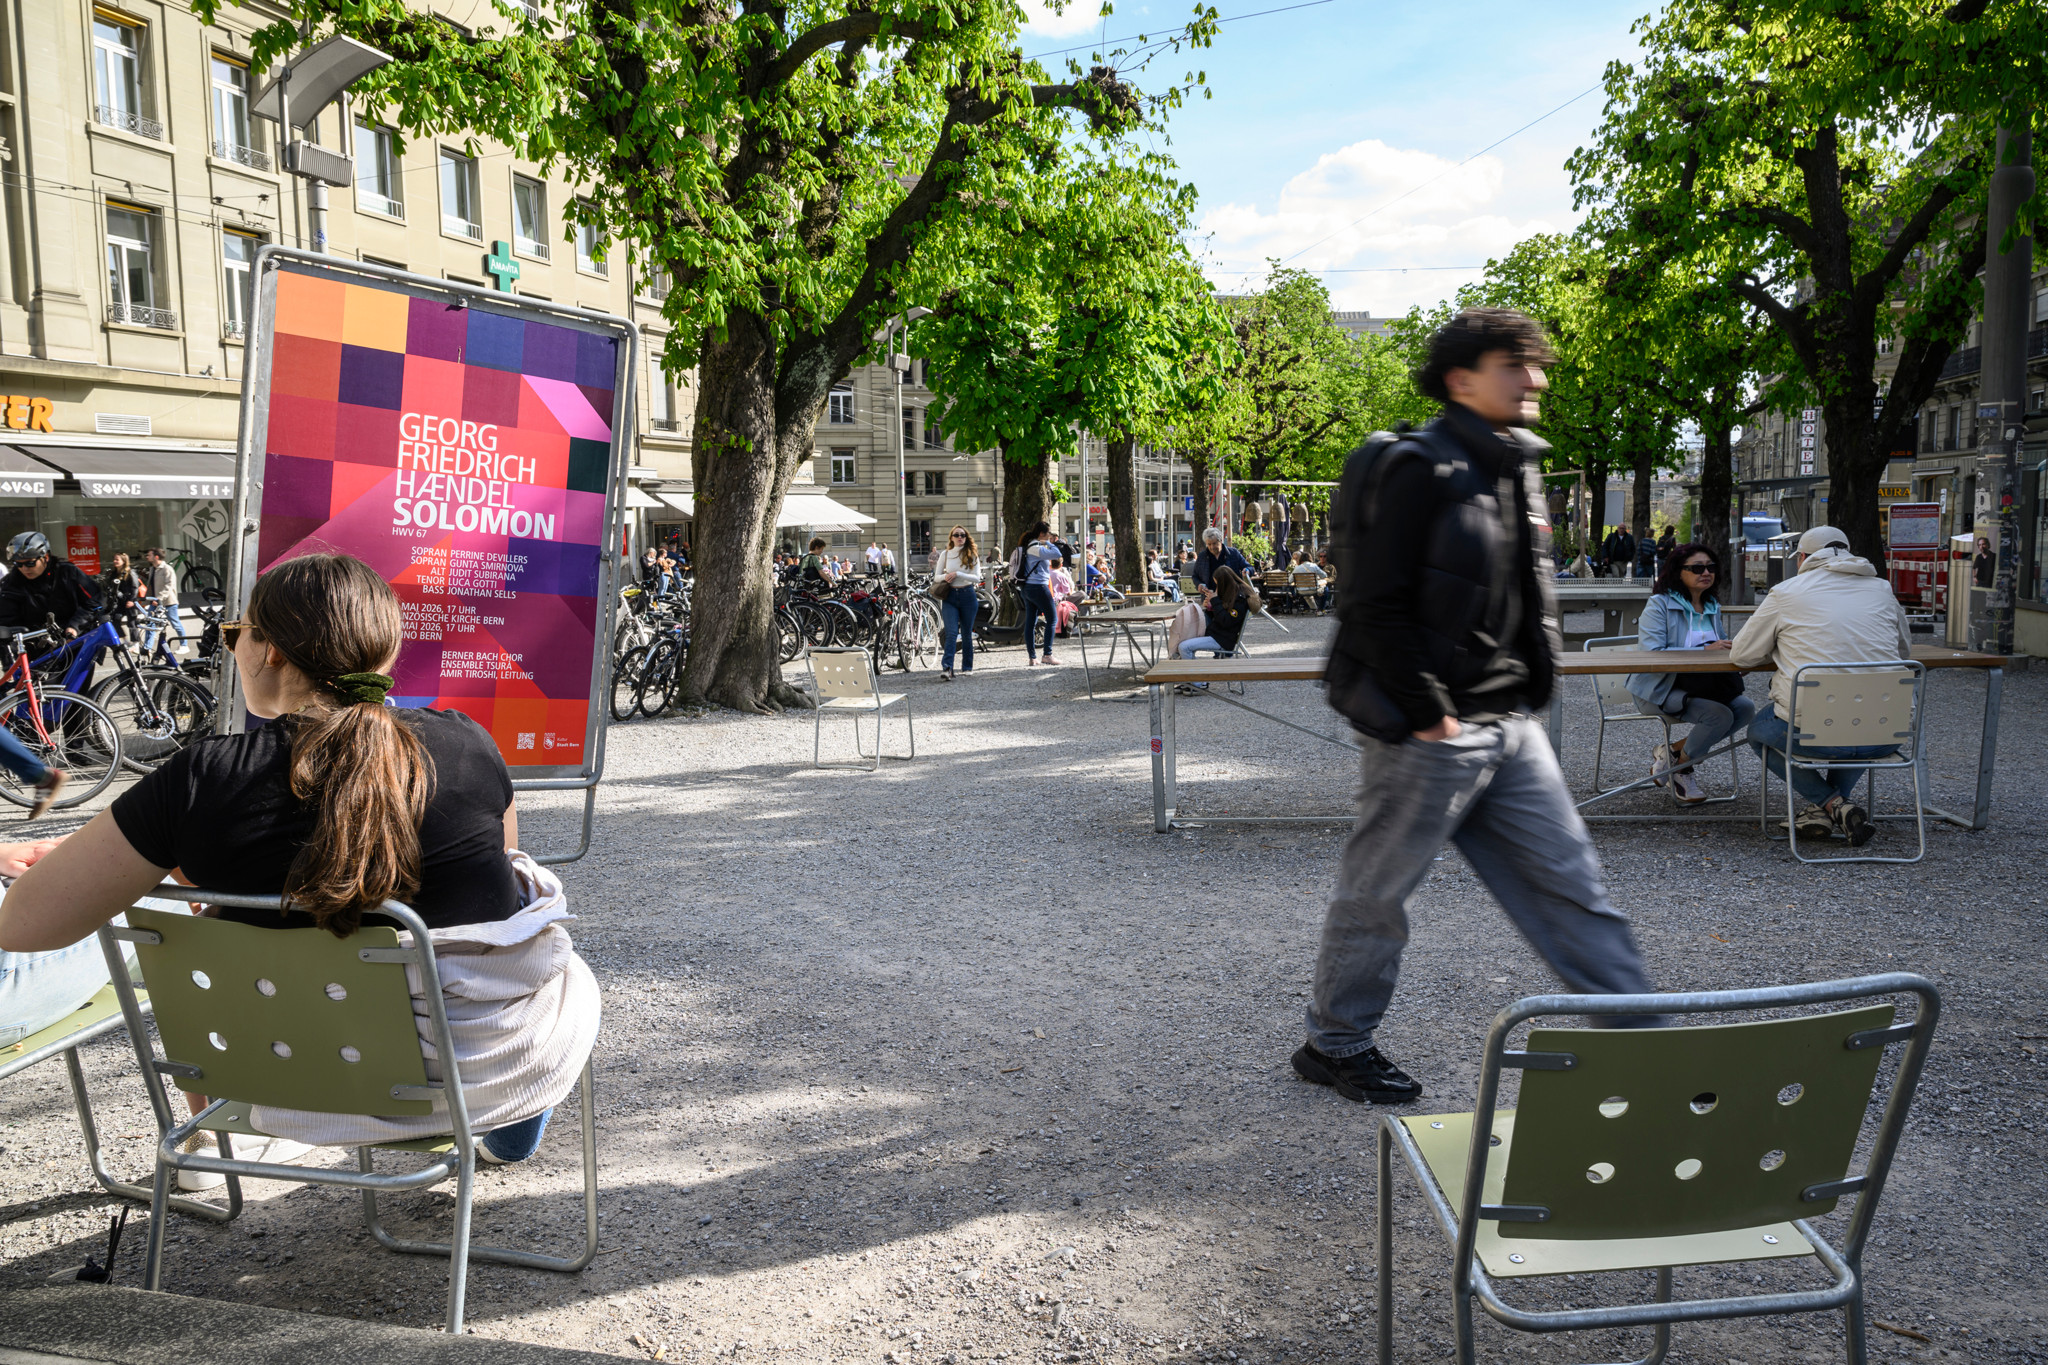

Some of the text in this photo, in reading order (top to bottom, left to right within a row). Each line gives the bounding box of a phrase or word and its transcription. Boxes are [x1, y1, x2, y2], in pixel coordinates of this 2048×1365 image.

[399, 412, 498, 451] GEORG
[1804, 411, 1814, 474] HOTEL
[397, 440, 536, 484] FRIEDRICH
[395, 468, 515, 509] HÆNDEL
[392, 497, 555, 540] SOLOMON
[392, 527, 427, 538] HWV 67
[70, 547, 97, 556] Outlet
[411, 546, 528, 564] SOPRAN PERRINE DEVILLERS
[410, 556, 524, 573] SOPRAN GUNTA SMIRNOVA
[430, 567, 516, 581] ALT JUDIT SUBIRANA
[416, 575, 497, 589] TENOR LUCA GOTTI
[422, 585, 517, 599] BASS JONATHAN SELLS
[401, 602, 476, 615] MAI 2026, 17 UHR
[401, 611, 505, 626] NZÖSISCHE KIRCHE BERN
[401, 621, 475, 633] MAI 2026, 17 UHR
[420, 632, 442, 640] BERN
[441, 651, 523, 662] BERNER BACH CHOR
[441, 660, 483, 670] ENSEMBLE
[440, 669, 534, 680] AMIR TIROSHI, LEITUNG
